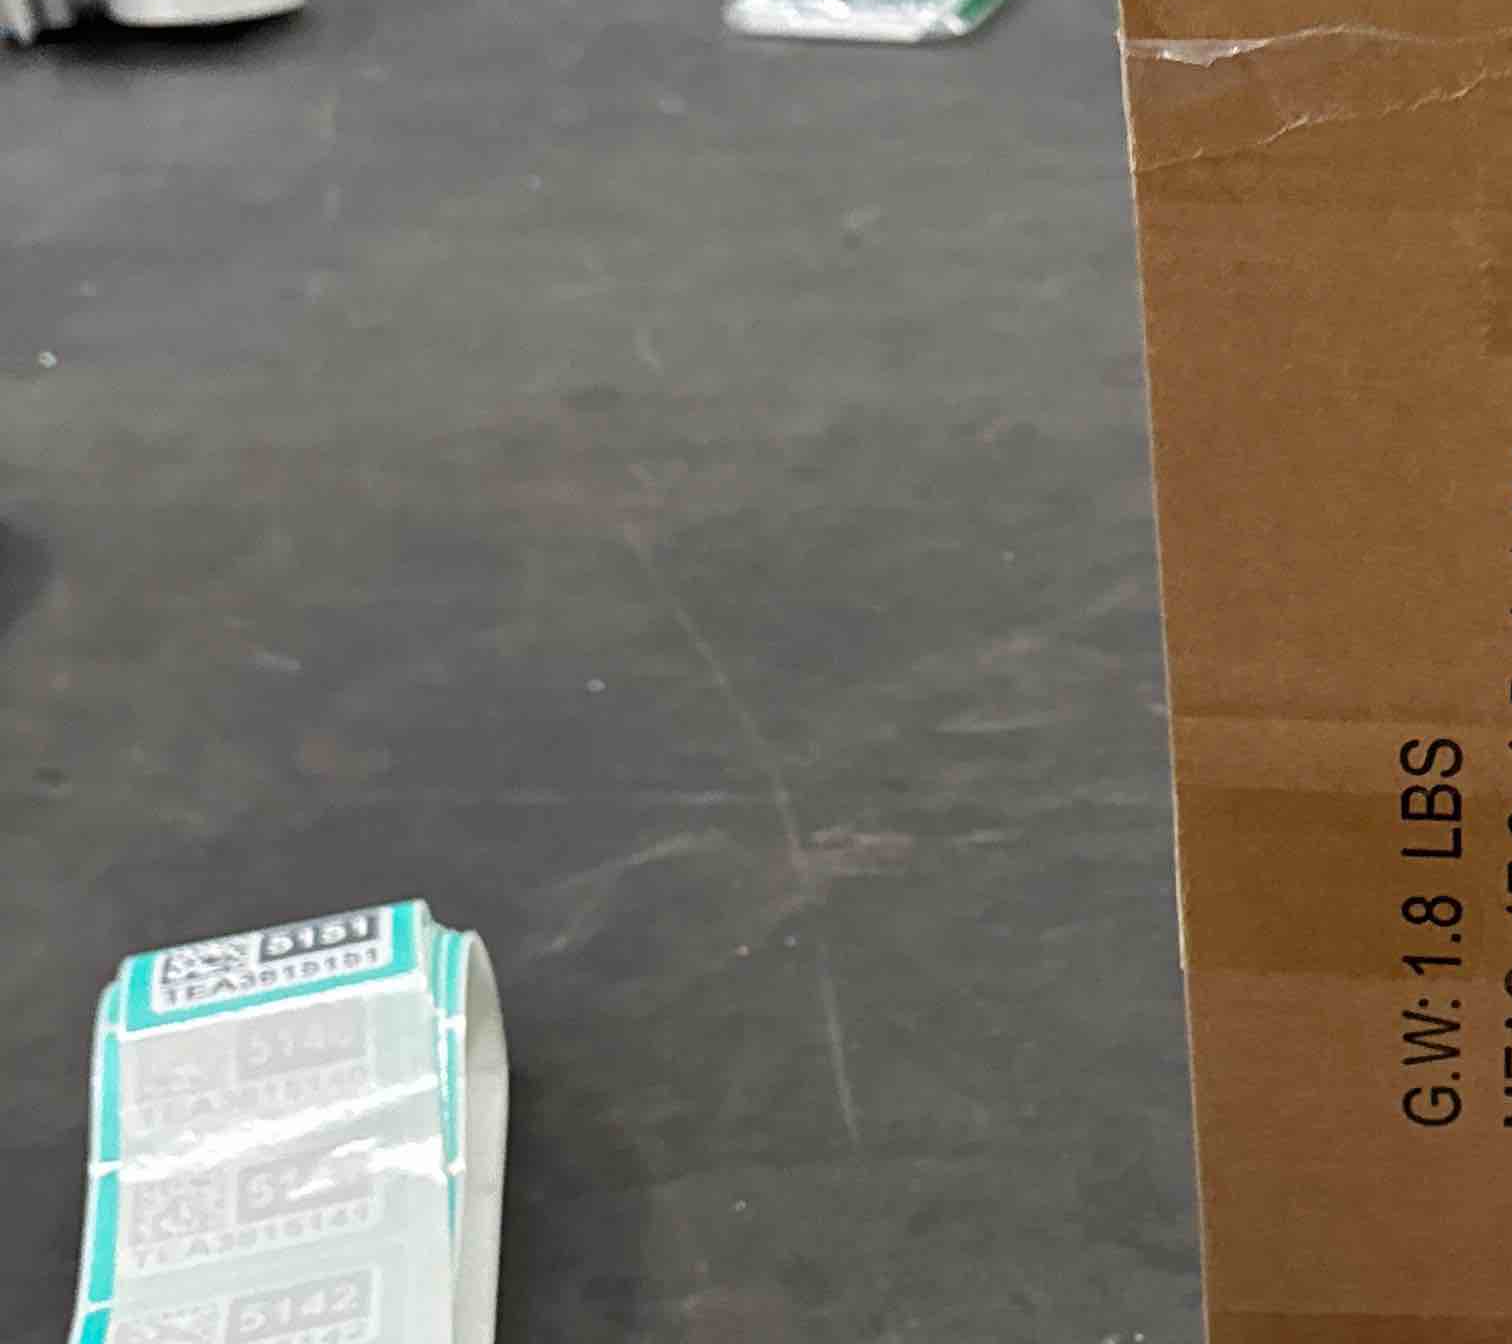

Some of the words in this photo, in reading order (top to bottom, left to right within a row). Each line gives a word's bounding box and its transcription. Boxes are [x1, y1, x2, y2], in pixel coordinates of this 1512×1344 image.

[1400, 738, 1463, 860] LBS
[1401, 895, 1463, 977] 1.8
[1402, 998, 1462, 1127] G.W:
